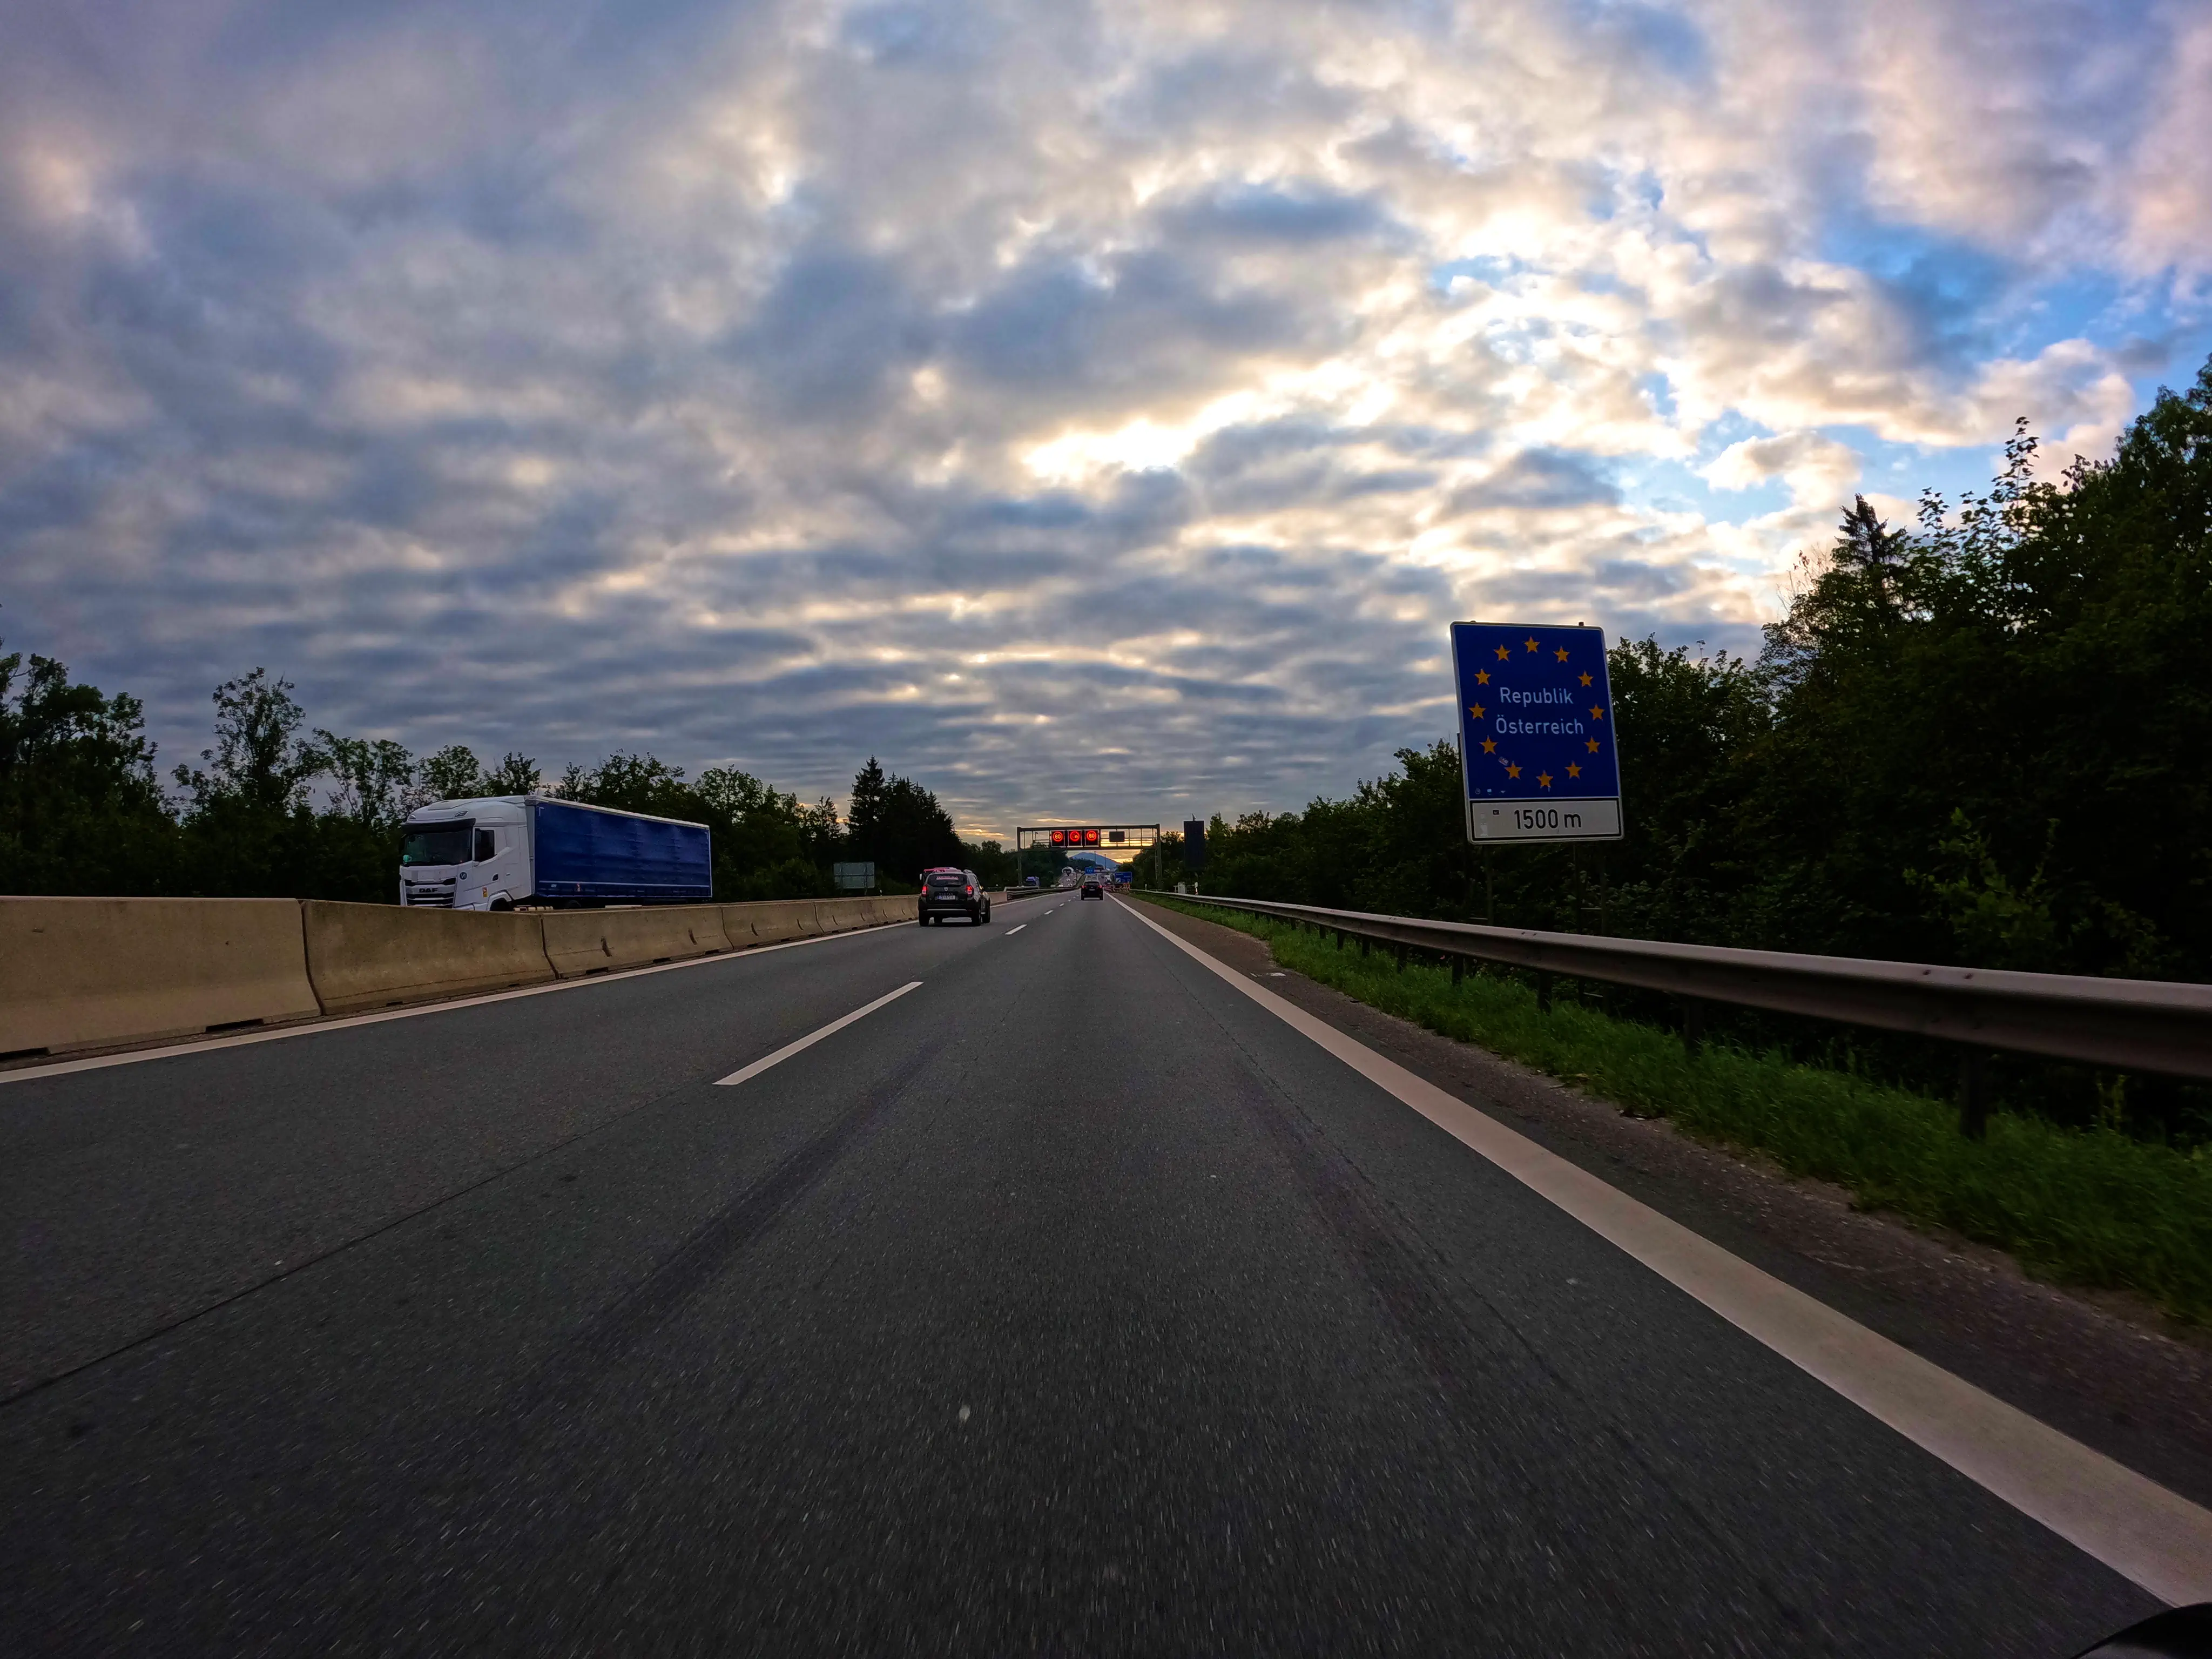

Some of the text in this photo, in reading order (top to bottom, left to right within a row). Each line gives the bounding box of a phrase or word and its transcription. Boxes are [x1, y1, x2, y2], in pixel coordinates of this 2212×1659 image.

[1500, 686, 1574, 707] Republik
[1495, 714, 1584, 734] Österreich
[1514, 809, 1582, 829] 1500 m
